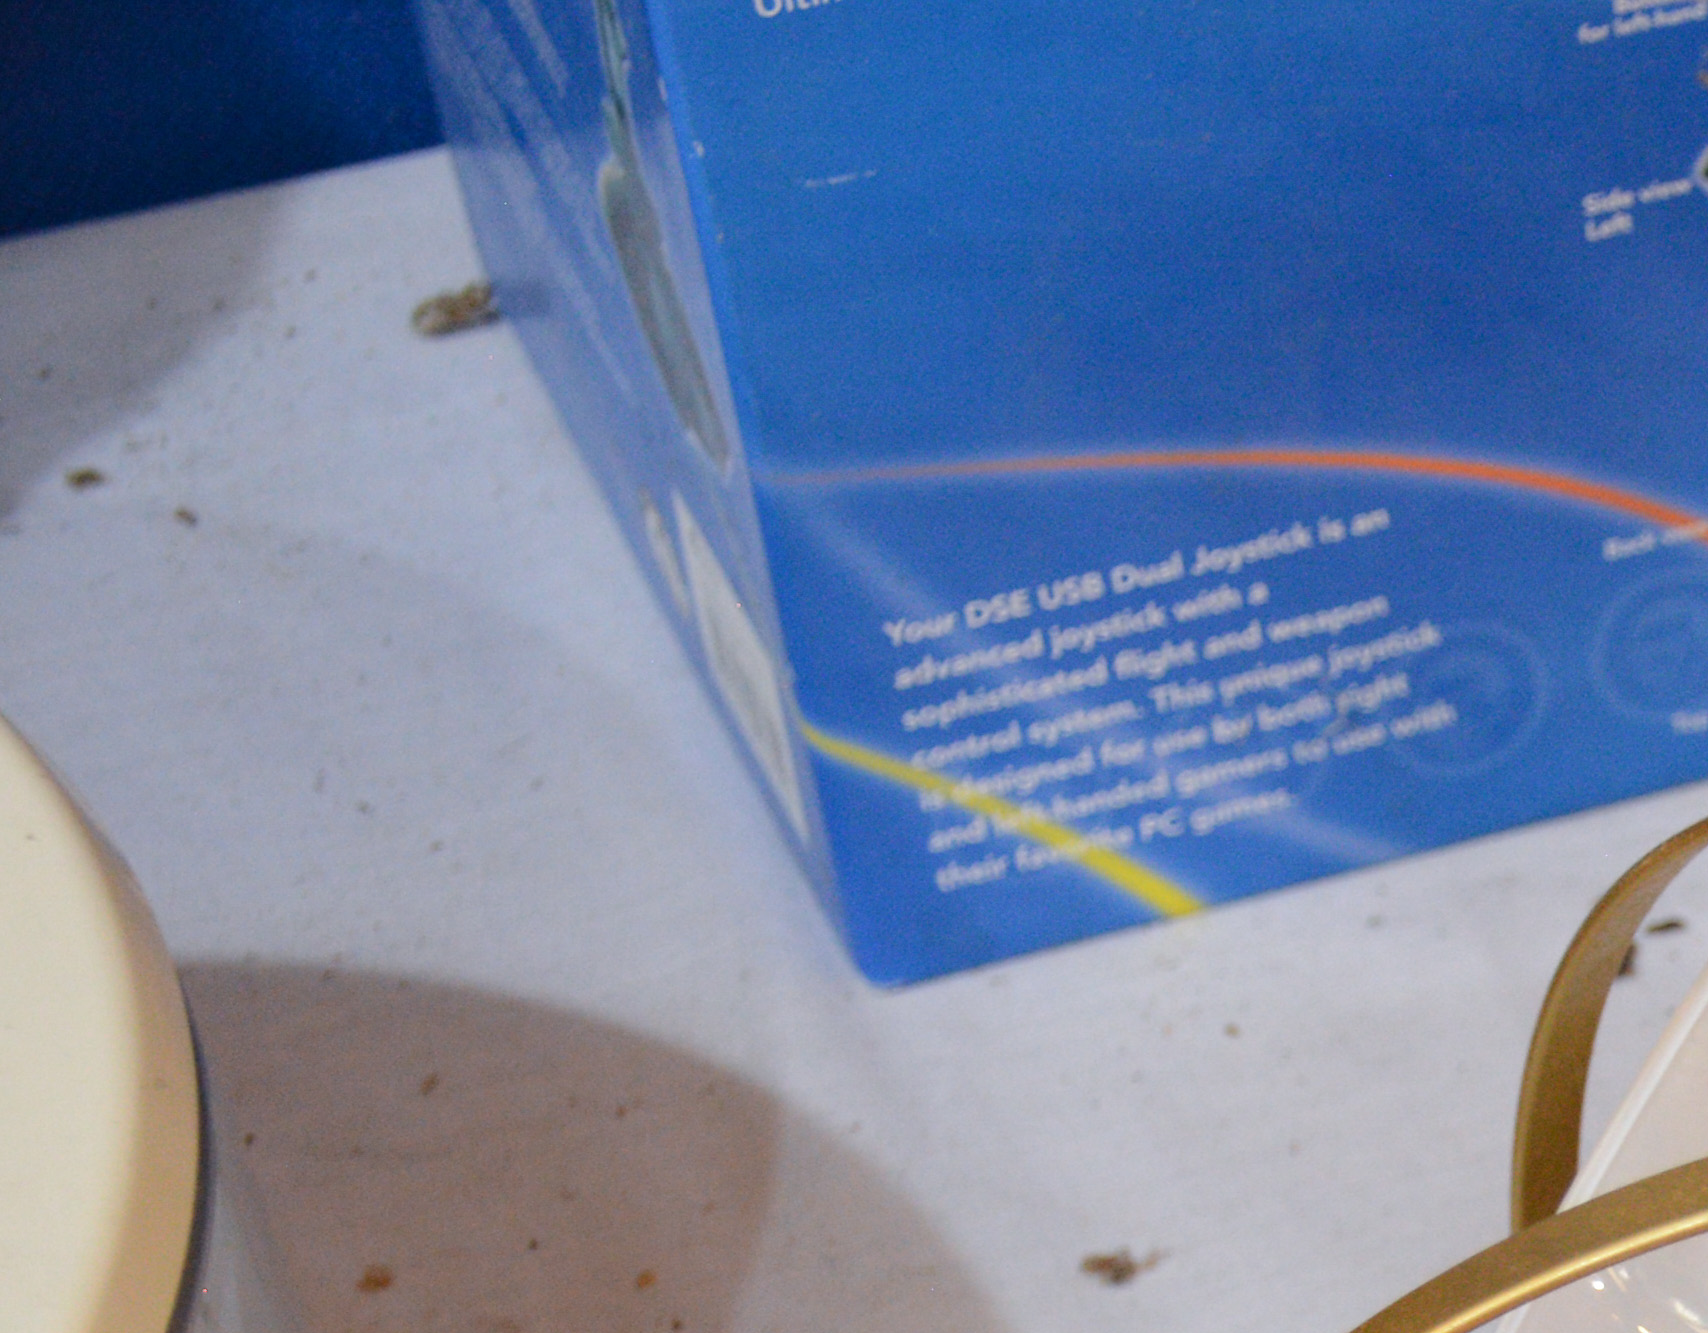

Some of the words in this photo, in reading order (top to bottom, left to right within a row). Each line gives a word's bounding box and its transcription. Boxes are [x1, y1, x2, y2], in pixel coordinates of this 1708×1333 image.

[883, 611, 957, 646] Your
[964, 588, 1032, 629] DSE
[1037, 571, 1105, 611] USB
[1110, 551, 1184, 594] Dual
[1191, 522, 1311, 576] Joystick
[1318, 515, 1346, 543] is
[894, 629, 1045, 690] advanced
[1050, 602, 1167, 660] joystick
[1172, 583, 1242, 623] with
[902, 656, 1109, 731] sophisticated
[1113, 639, 1196, 681] flight
[1202, 618, 1263, 659] and
[1267, 594, 1390, 643] weapon
[911, 720, 1022, 769] control
[1148, 680, 1215, 713] This
[1327, 619, 1442, 678] joystick
[1100, 735, 1146, 767] for
[928, 815, 987, 853] and
[1138, 807, 1184, 843] PC
